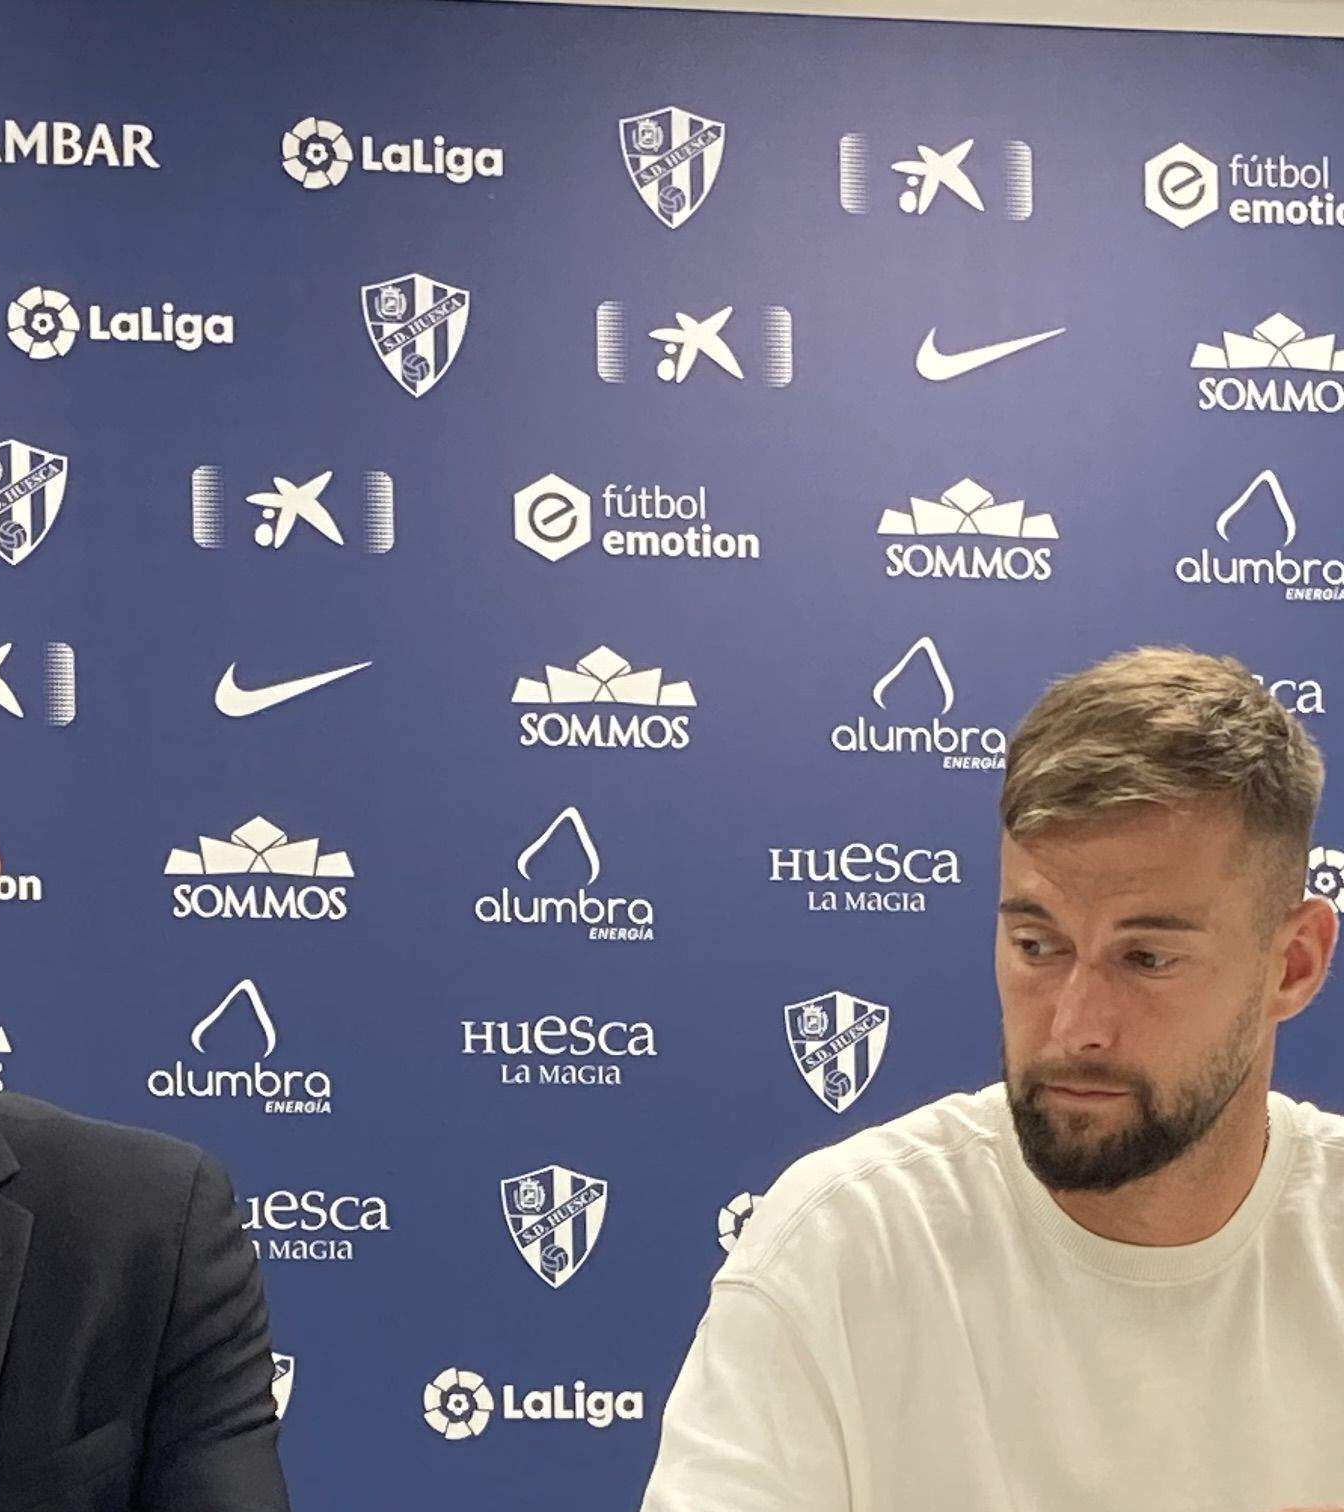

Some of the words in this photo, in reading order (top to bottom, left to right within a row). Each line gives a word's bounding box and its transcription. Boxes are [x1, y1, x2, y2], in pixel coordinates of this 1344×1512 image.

[363, 136, 503, 183] LaLiga
[1229, 154, 1328, 189] fútbol
[90, 303, 233, 351] LaLiga
[602, 484, 705, 519] fútbol
[603, 524, 759, 558] emotion
[886, 544, 1051, 580] SOMMOS
[521, 713, 689, 748] SOMMOS
[832, 717, 1006, 754] alumbra
[174, 884, 346, 919] SOMMOS
[476, 888, 652, 924] alumbra
[148, 1061, 330, 1097] alumbra
[503, 1381, 643, 1427] LaLiga
